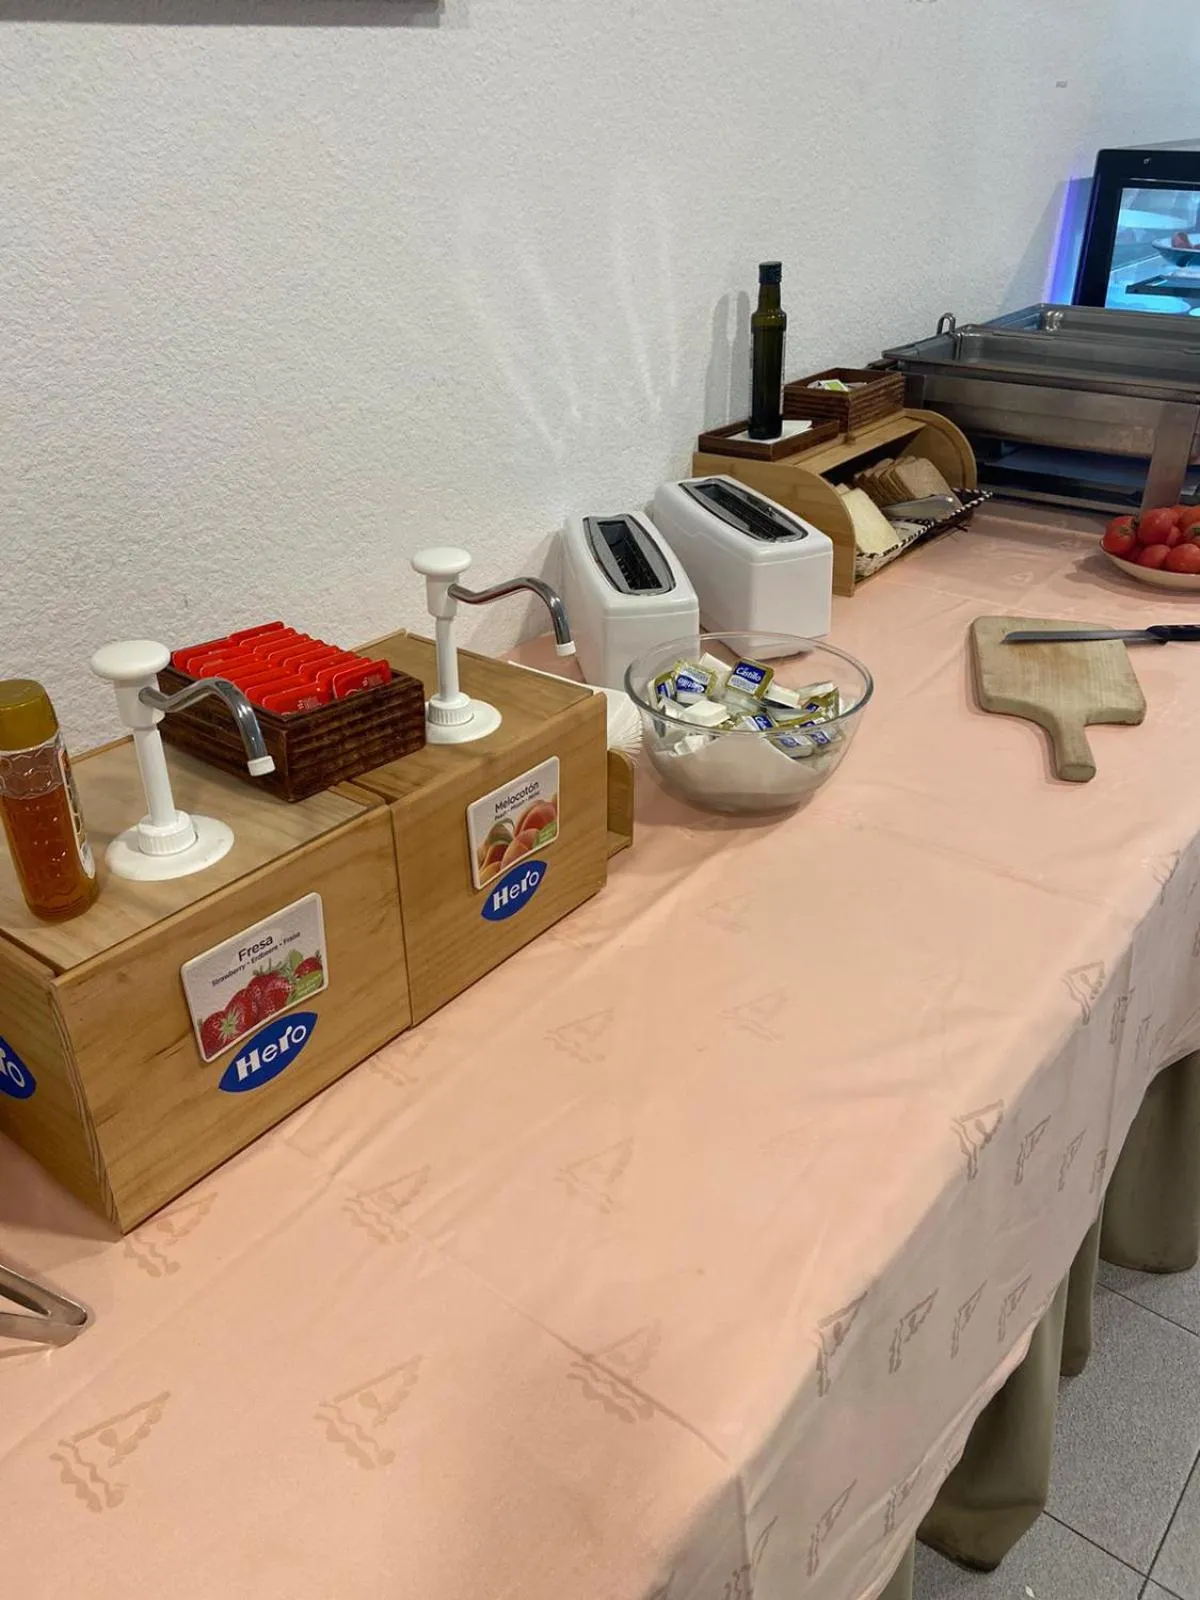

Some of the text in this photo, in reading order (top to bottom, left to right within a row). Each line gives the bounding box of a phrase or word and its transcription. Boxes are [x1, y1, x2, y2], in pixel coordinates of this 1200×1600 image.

[735, 666, 760, 681] Castillo
[495, 781, 539, 813] Melocotón
[492, 870, 541, 912] Hero
[238, 936, 273, 962] Fresa
[236, 1025, 307, 1082] Hero
